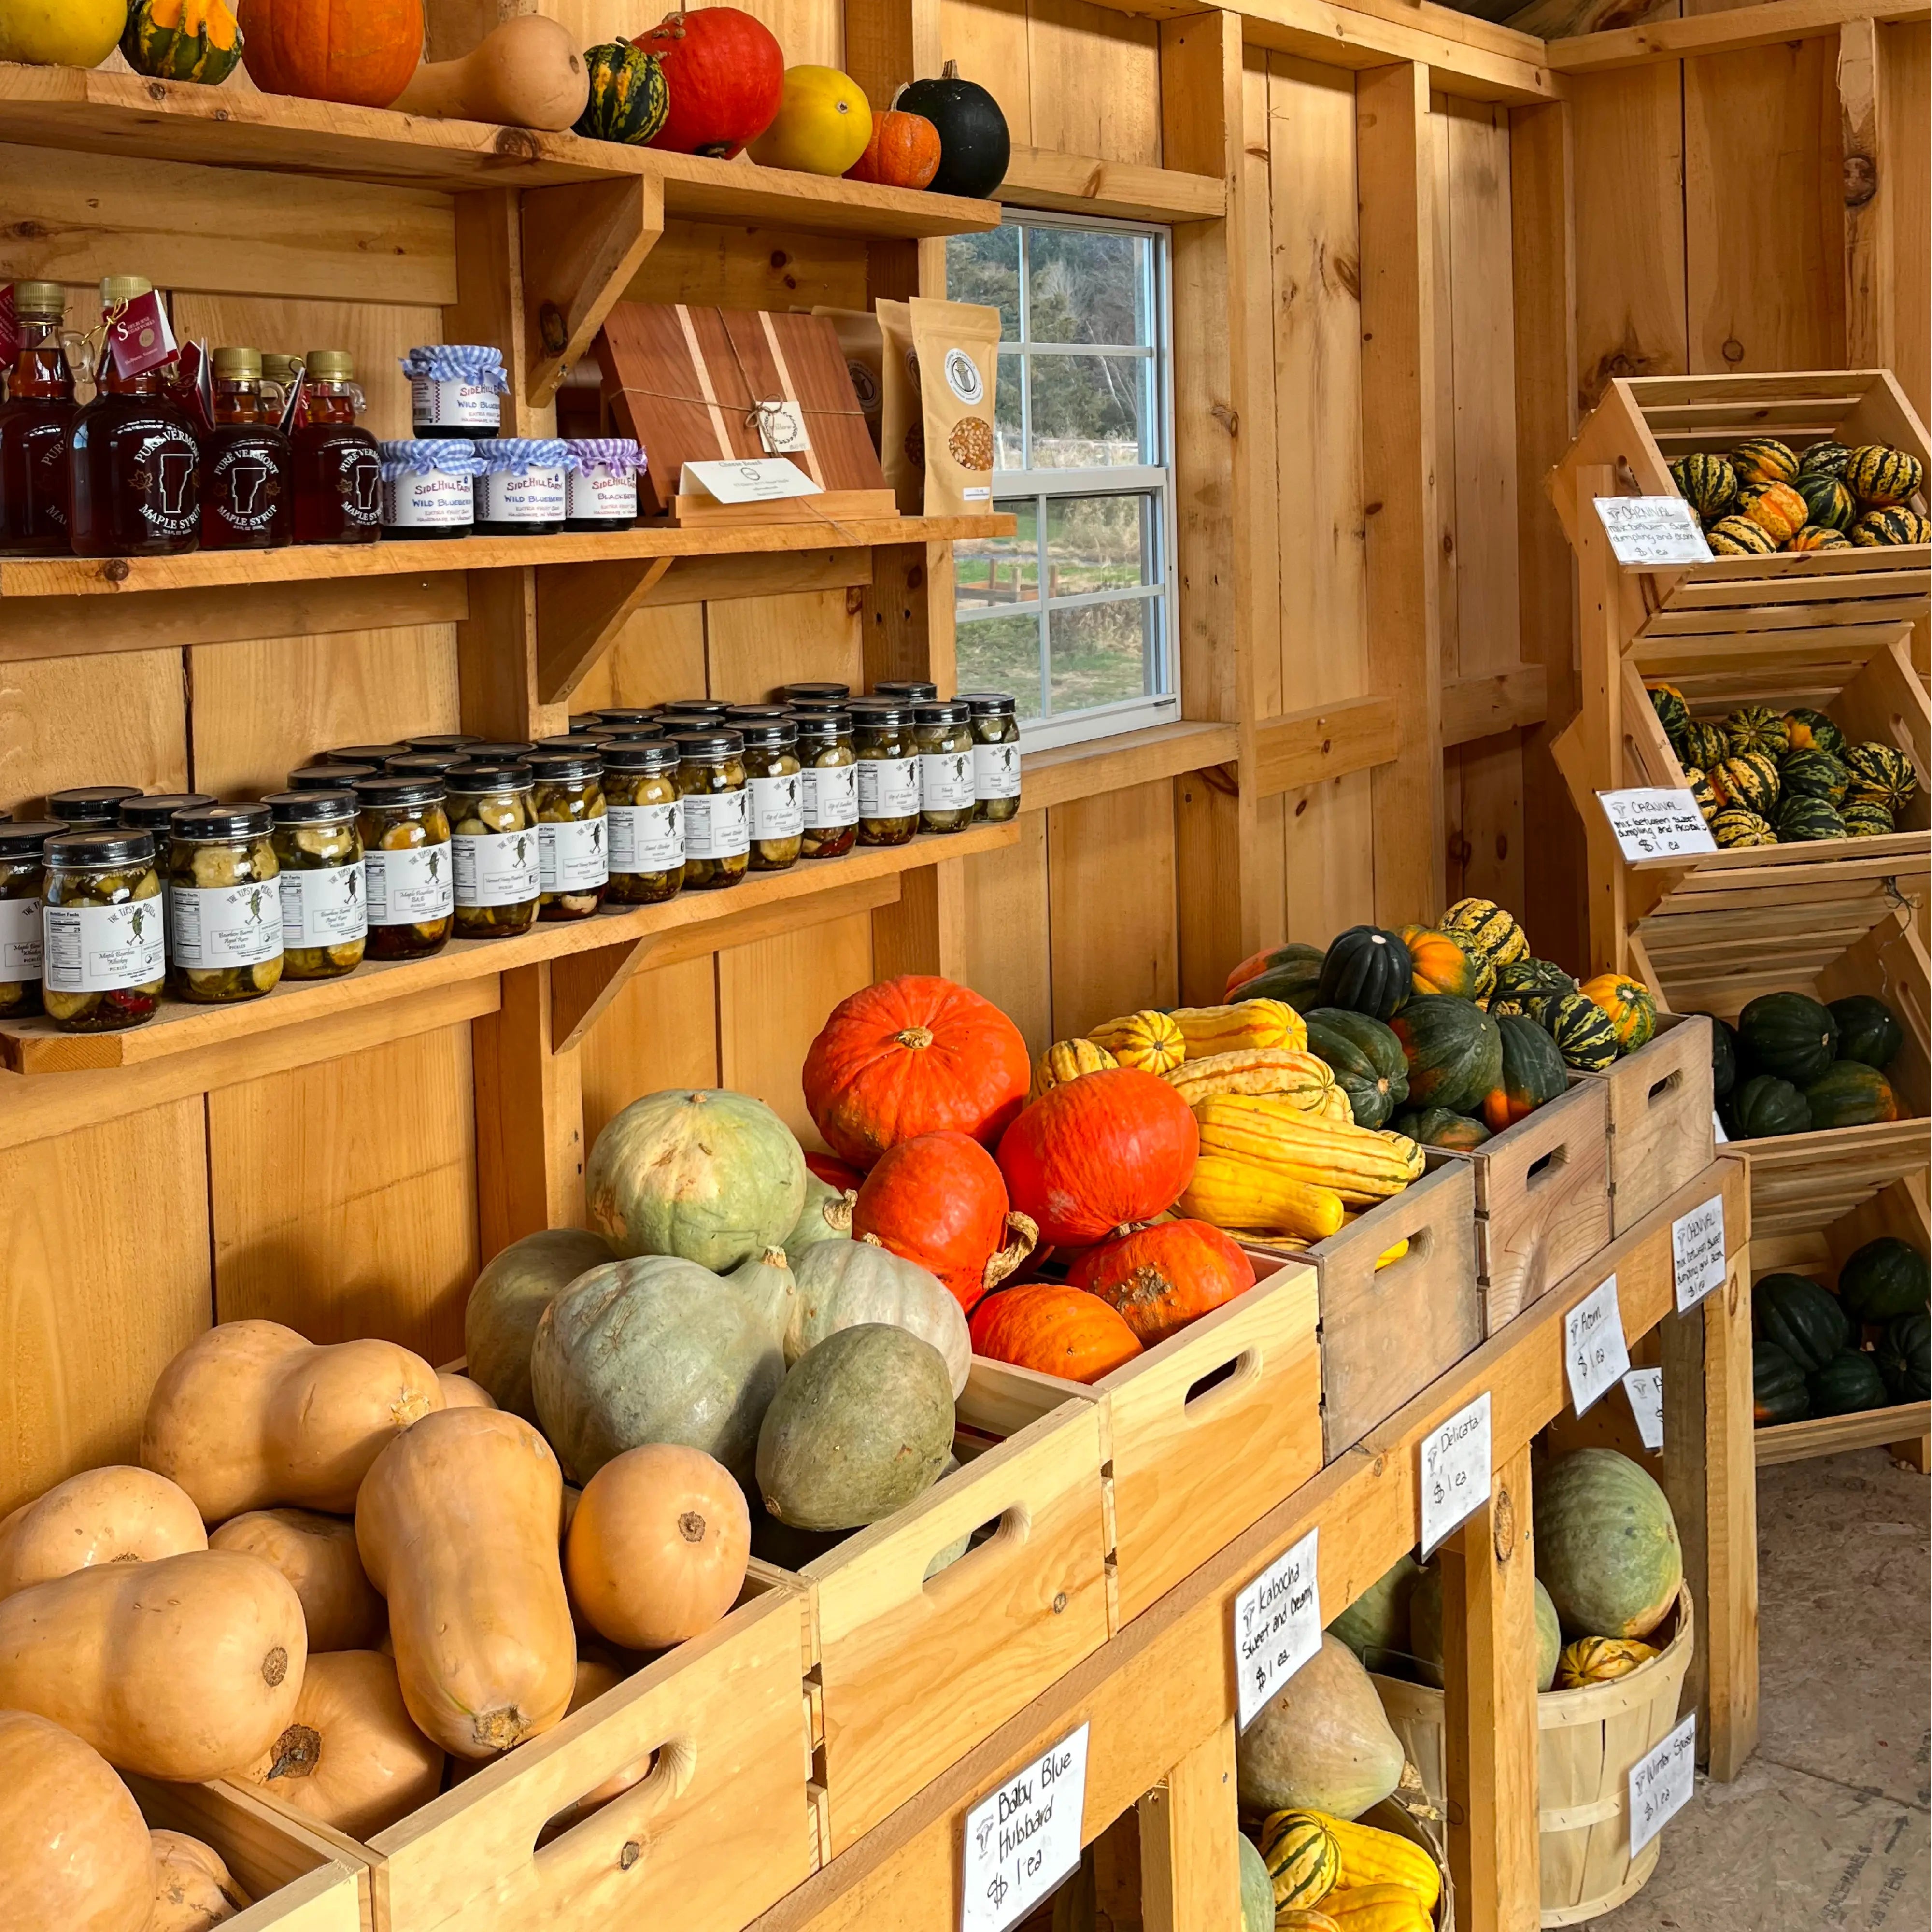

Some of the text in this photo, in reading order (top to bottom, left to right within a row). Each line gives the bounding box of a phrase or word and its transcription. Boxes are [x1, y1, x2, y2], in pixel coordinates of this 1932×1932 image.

[457, 400, 477, 408] WILD
[41, 440, 64, 465] PUR
[214, 449, 279, 475] PURE VERMONT
[339, 451, 360, 472] PURE
[411, 498, 434, 507] WILD
[504, 494, 525, 503] WILD
[139, 503, 177, 529] MAPLE
[217, 505, 277, 526] MAPLE SYRUP
[341, 501, 369, 521] MAPLE
[1631, 801, 1683, 813] CARNIVAL
[1632, 818, 1671, 826] between
[1618, 827, 1657, 839] dumpling
[227, 895, 238, 904] THE
[237, 886, 254, 898] TIPSY
[107, 913, 120, 923] THE
[118, 905, 135, 917] TIPSY
[1440, 1414, 1480, 1453] Delicata
[1455, 1471, 1467, 1487] ea
[1273, 1602, 1288, 1633] and
[998, 1752, 1073, 1826] Baby Blue
[999, 1793, 1055, 1864] Hubbard
[1027, 1849, 1042, 1878] ea
